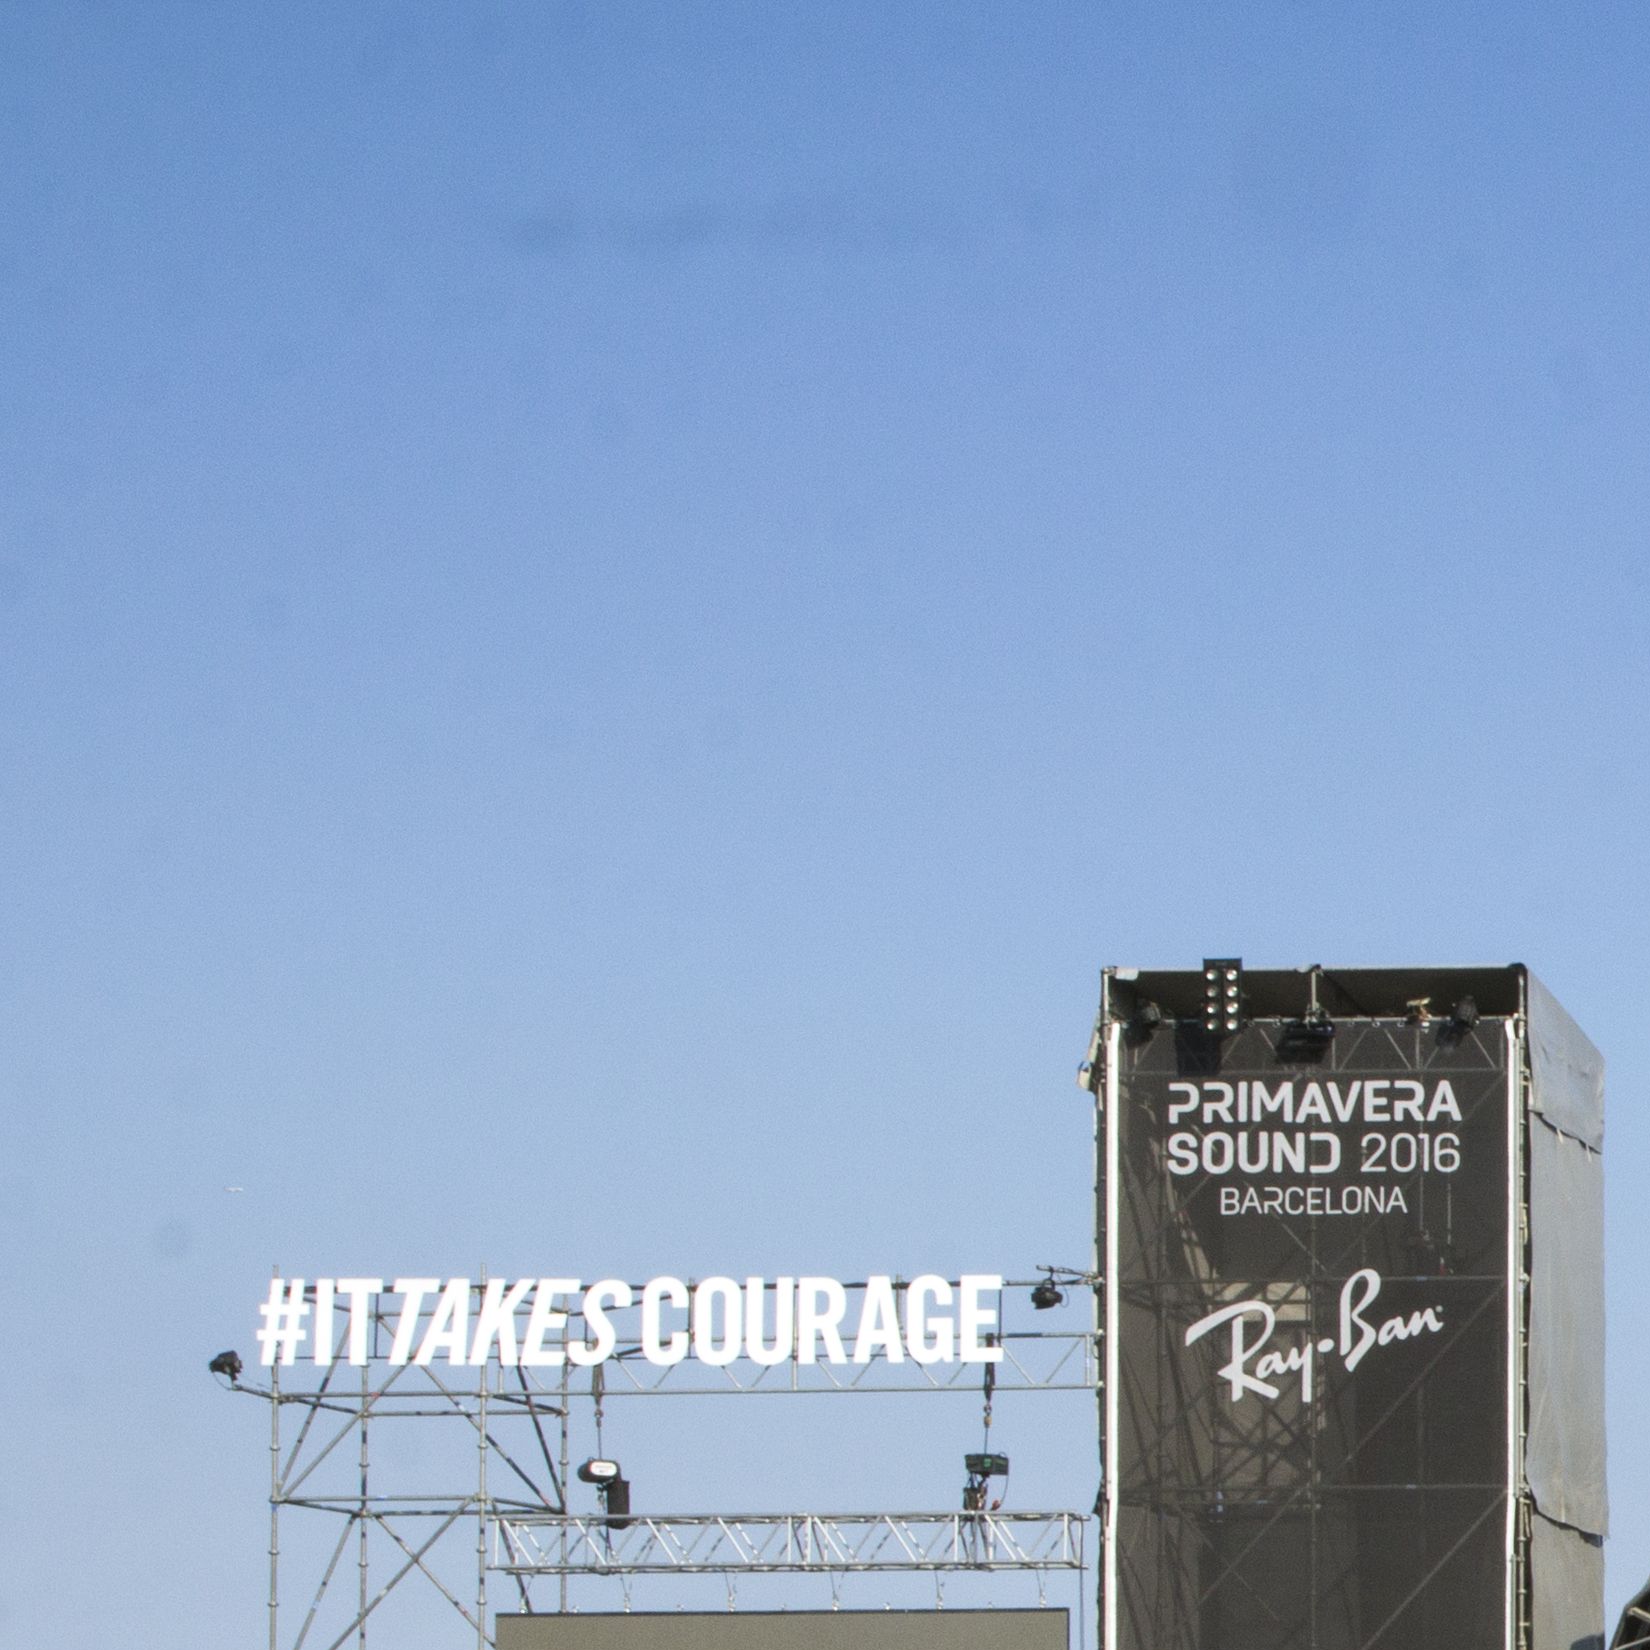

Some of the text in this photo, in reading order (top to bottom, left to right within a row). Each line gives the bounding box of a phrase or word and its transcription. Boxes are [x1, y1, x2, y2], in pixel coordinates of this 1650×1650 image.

[1167, 1080, 1462, 1124] PRIMAVERA
[1167, 1131, 1461, 1175] SOUND 2016
[1219, 1186, 1408, 1217] BARCELONA
